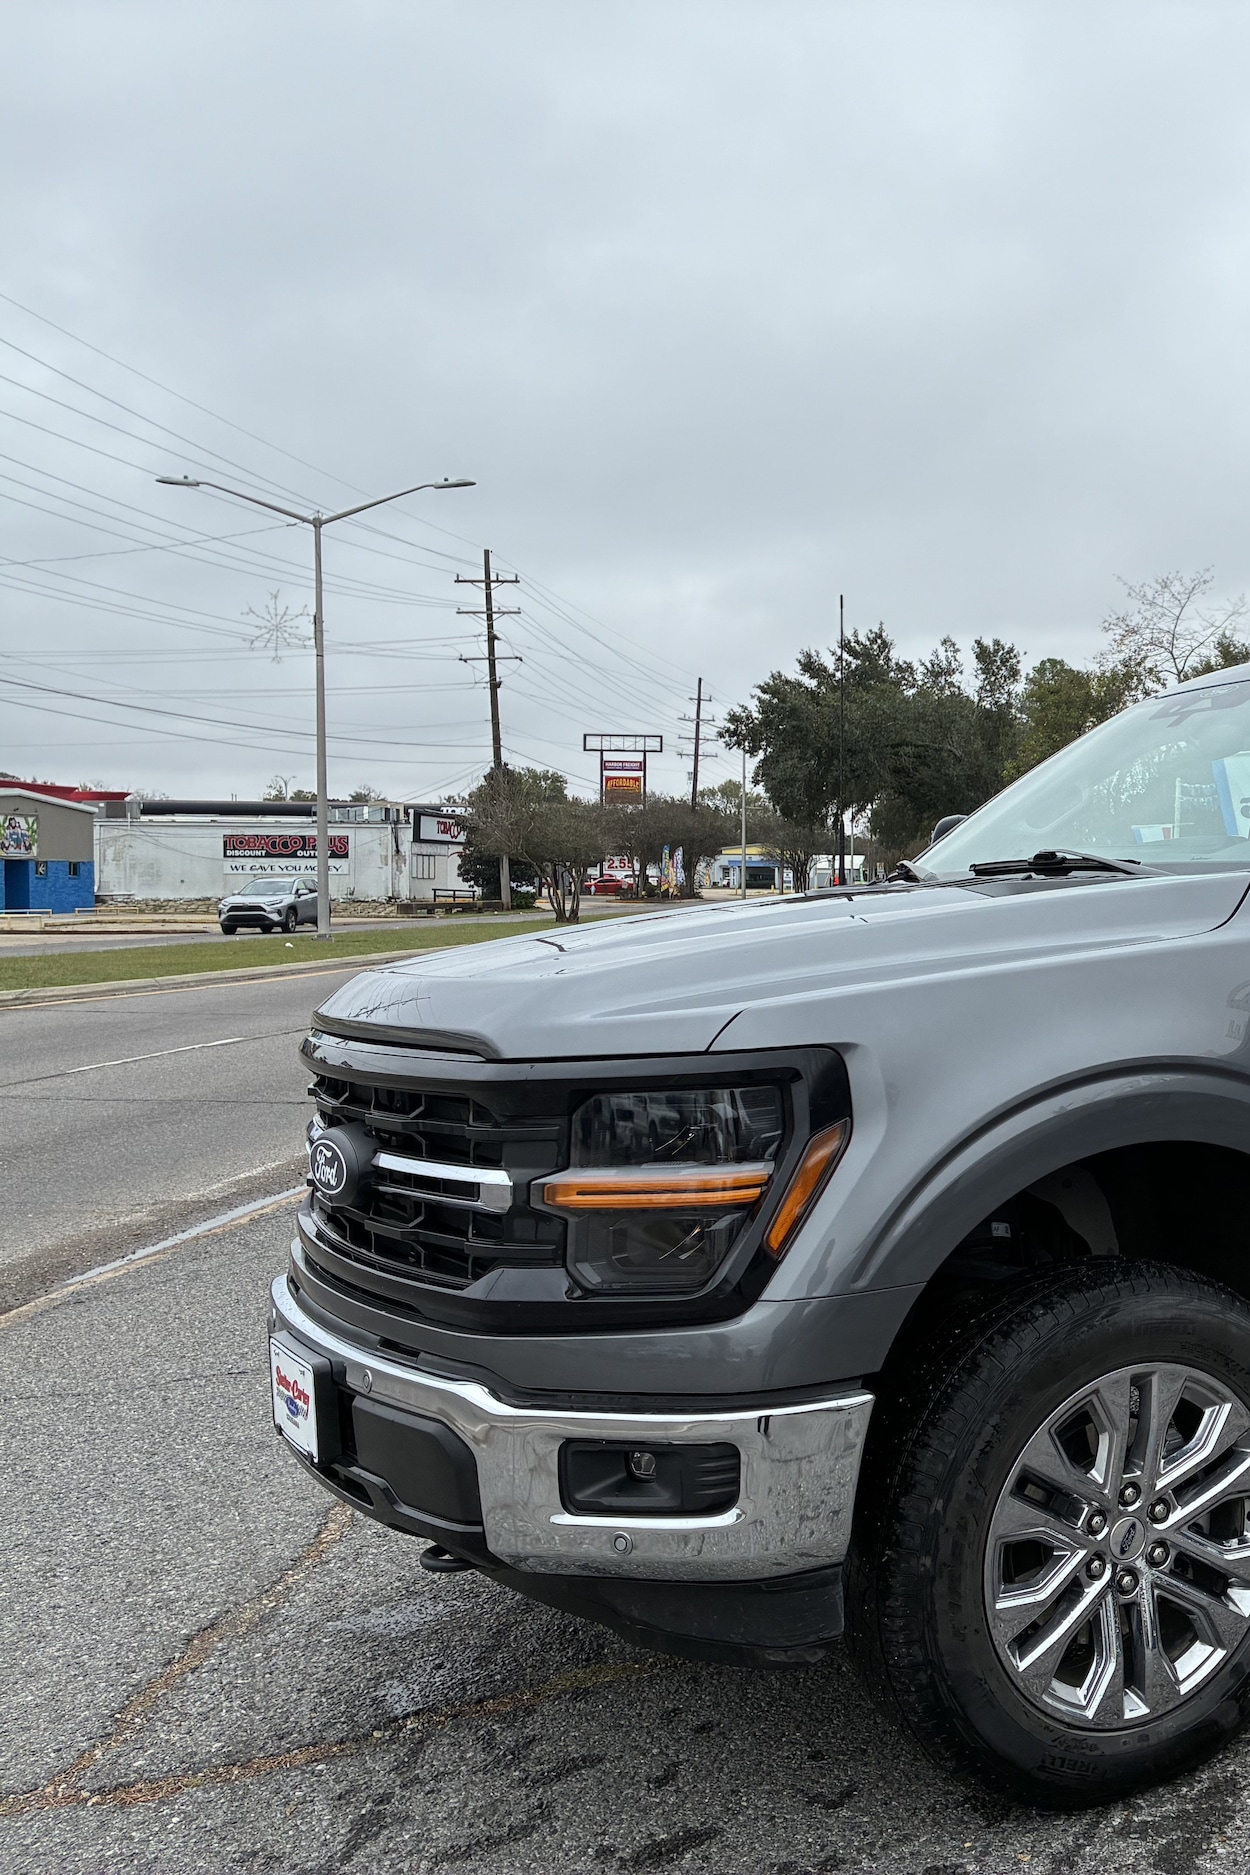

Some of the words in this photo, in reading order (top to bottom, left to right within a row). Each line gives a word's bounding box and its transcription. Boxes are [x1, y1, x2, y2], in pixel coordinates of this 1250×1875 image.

[224, 835, 303, 854] TOBACCO
[305, 836, 348, 855] PUS
[315, 1146, 338, 1187] Ford
